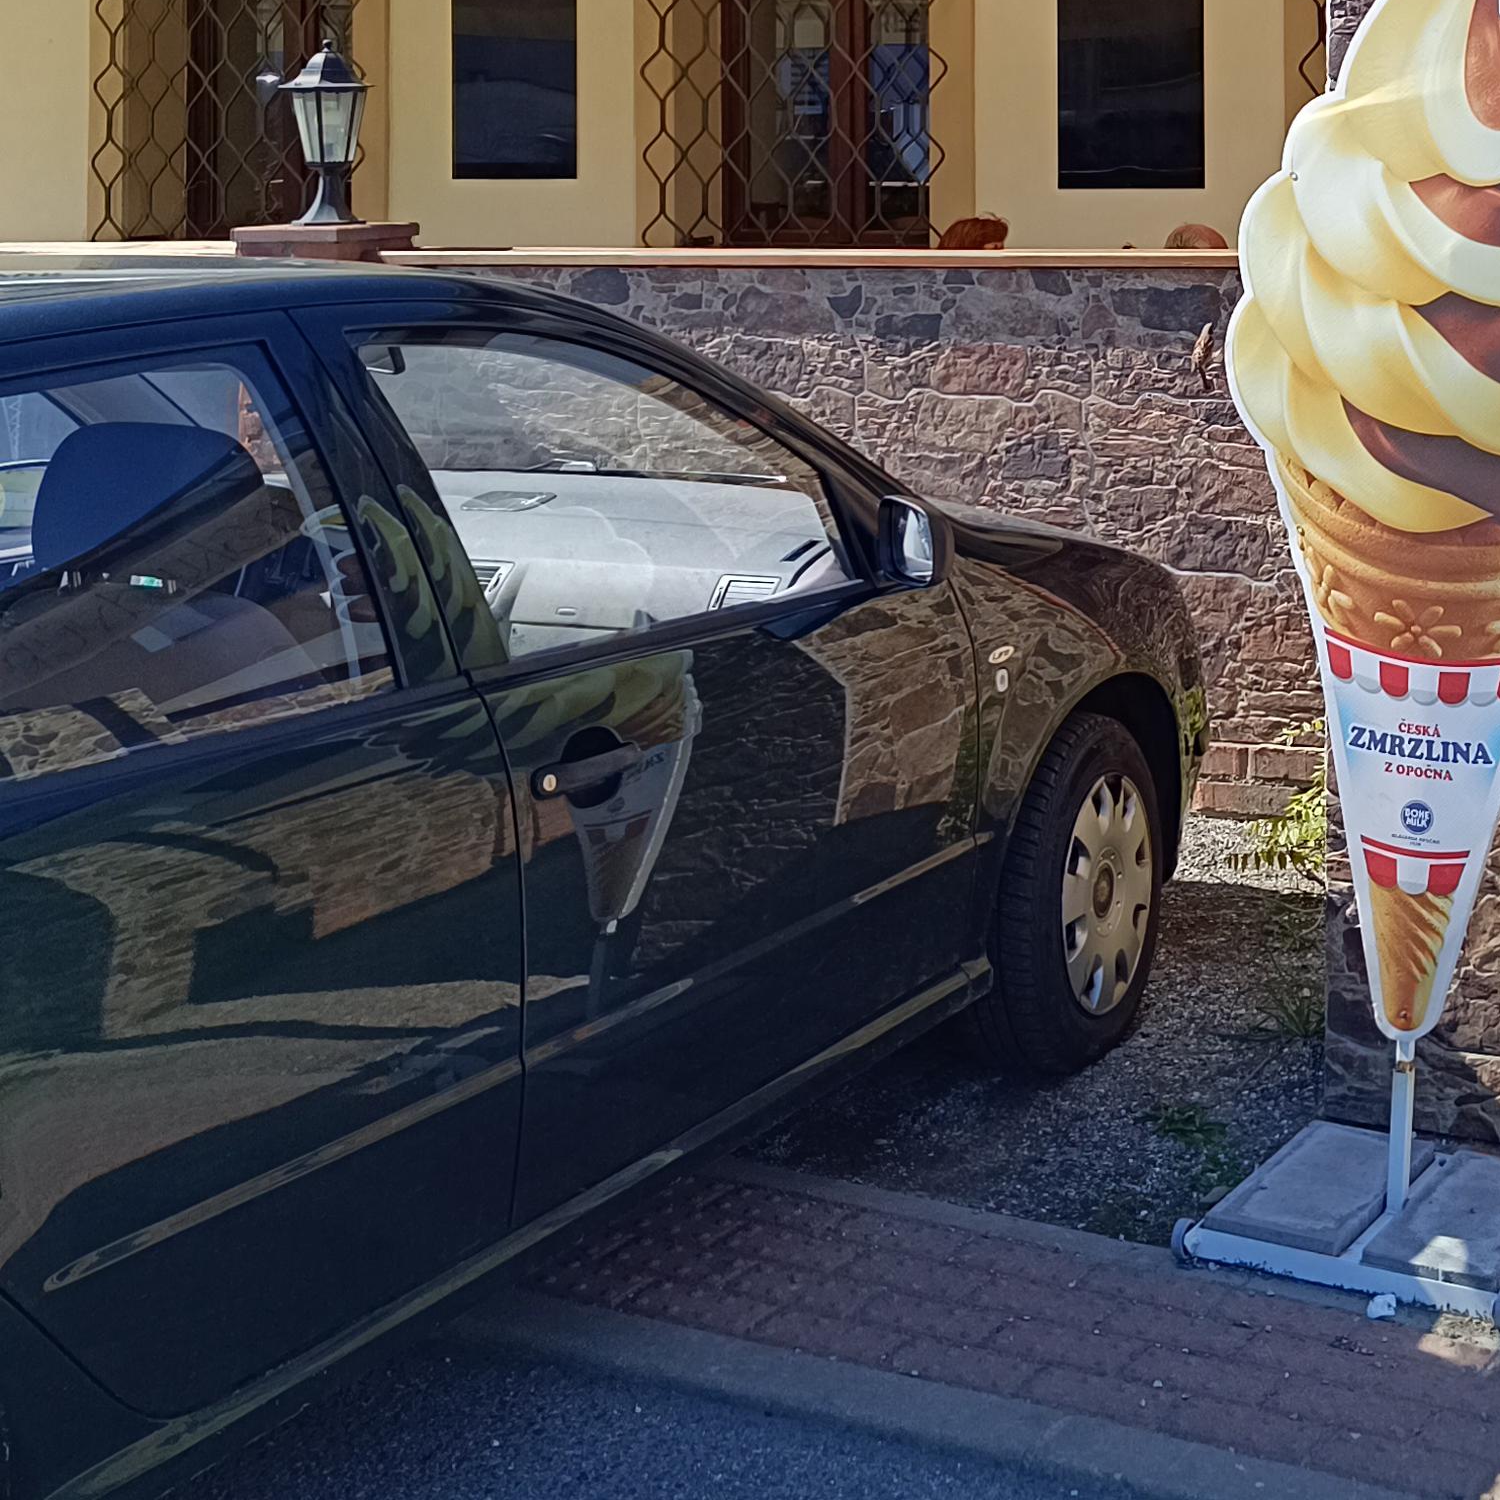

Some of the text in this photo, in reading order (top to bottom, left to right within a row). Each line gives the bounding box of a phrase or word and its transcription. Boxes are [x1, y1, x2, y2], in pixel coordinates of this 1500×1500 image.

[1398, 718, 1441, 738] ČESKÁ
[1348, 726, 1493, 765] ZMRZLINA
[1384, 762, 1453, 781] Z OPOČNA
